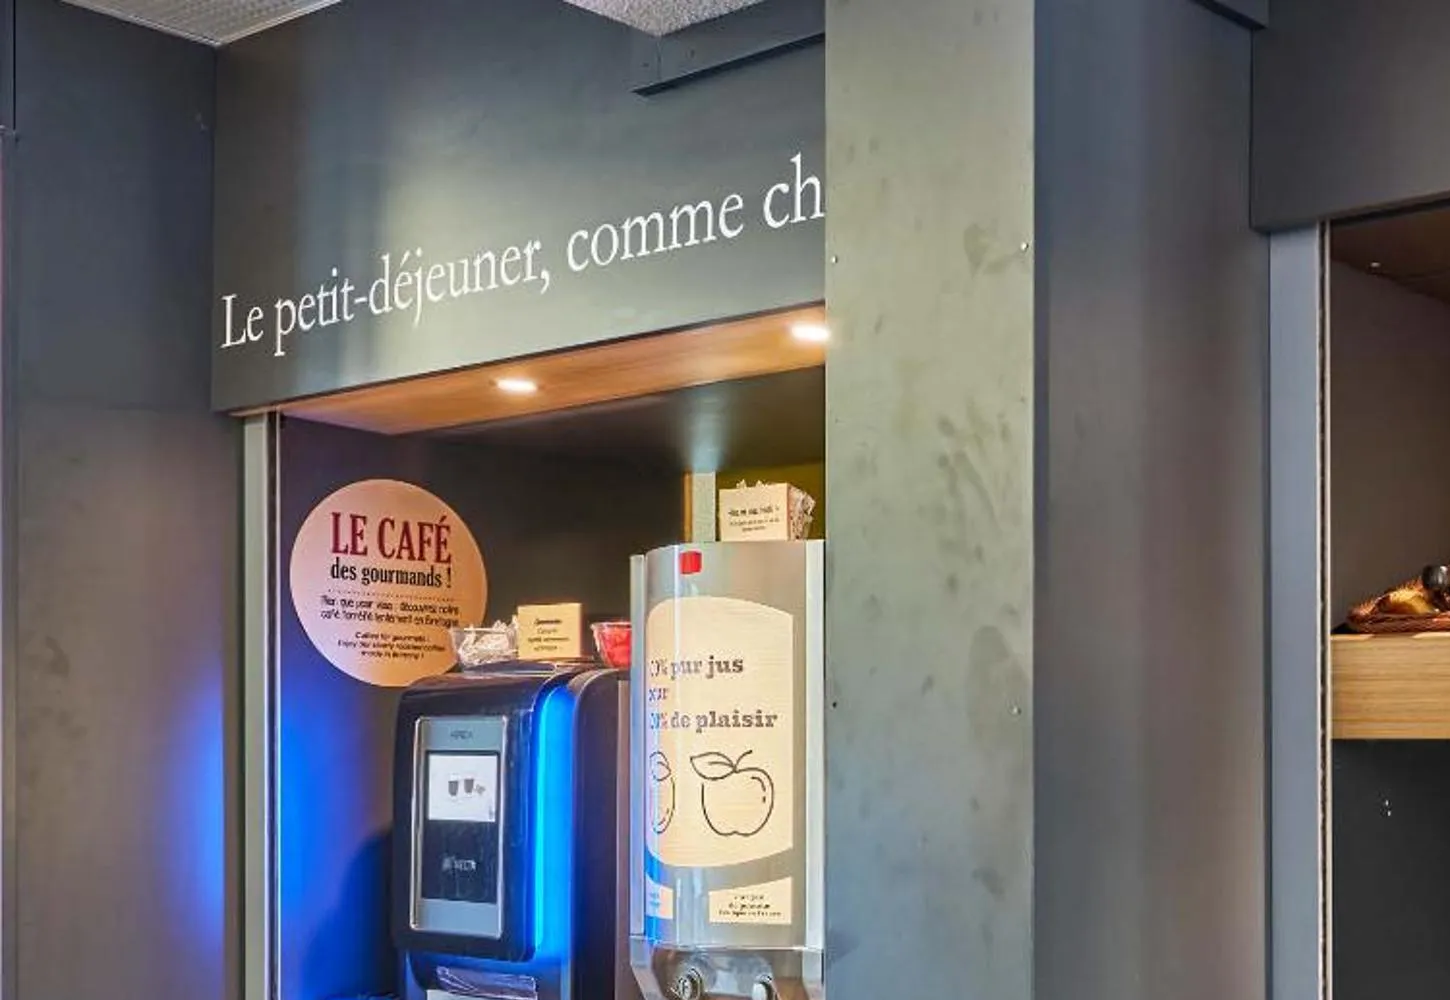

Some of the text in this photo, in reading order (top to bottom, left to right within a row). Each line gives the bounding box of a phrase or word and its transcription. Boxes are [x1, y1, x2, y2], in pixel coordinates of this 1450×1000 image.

[221, 153, 825, 357] Le petit-déjeuner, comme ch
[331, 512, 452, 564] LE CAFÉ
[331, 556, 357, 580] des
[361, 565, 442, 588] gourmands
[706, 655, 744, 679] jus
[670, 711, 691, 728] de
[695, 709, 778, 733] plaisir
